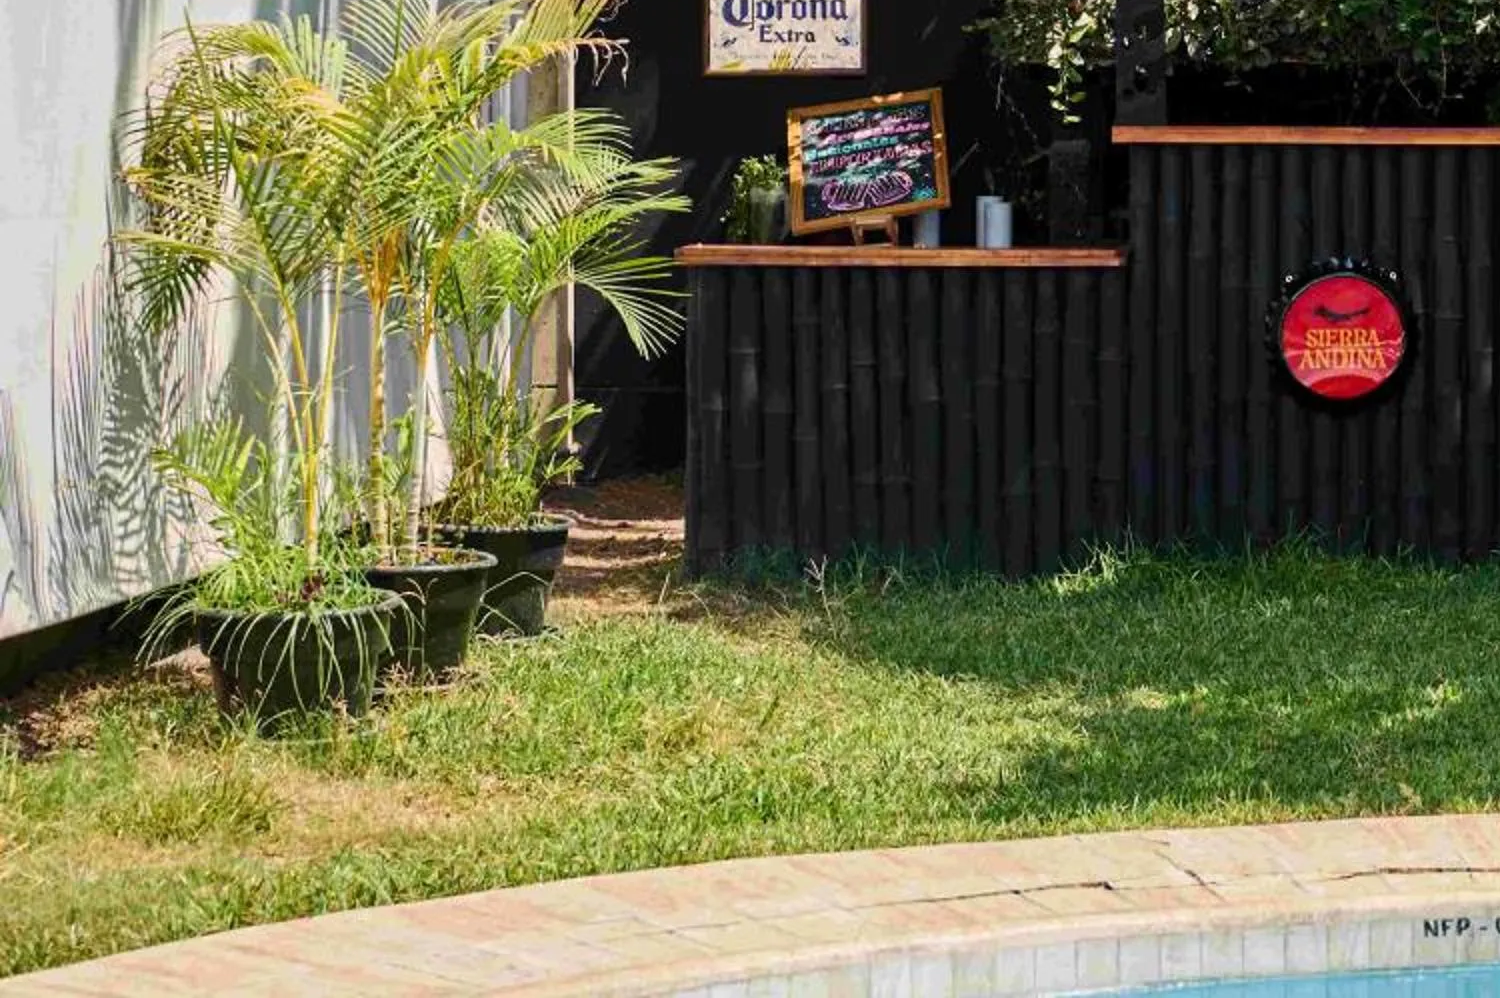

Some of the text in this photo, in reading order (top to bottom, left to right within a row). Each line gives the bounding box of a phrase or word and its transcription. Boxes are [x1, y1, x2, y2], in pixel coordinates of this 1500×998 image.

[759, 24, 816, 43] Extra
[1305, 328, 1381, 348] SIERRA
[1297, 348, 1387, 371] ANDINA
[1423, 917, 1471, 938] NFP
